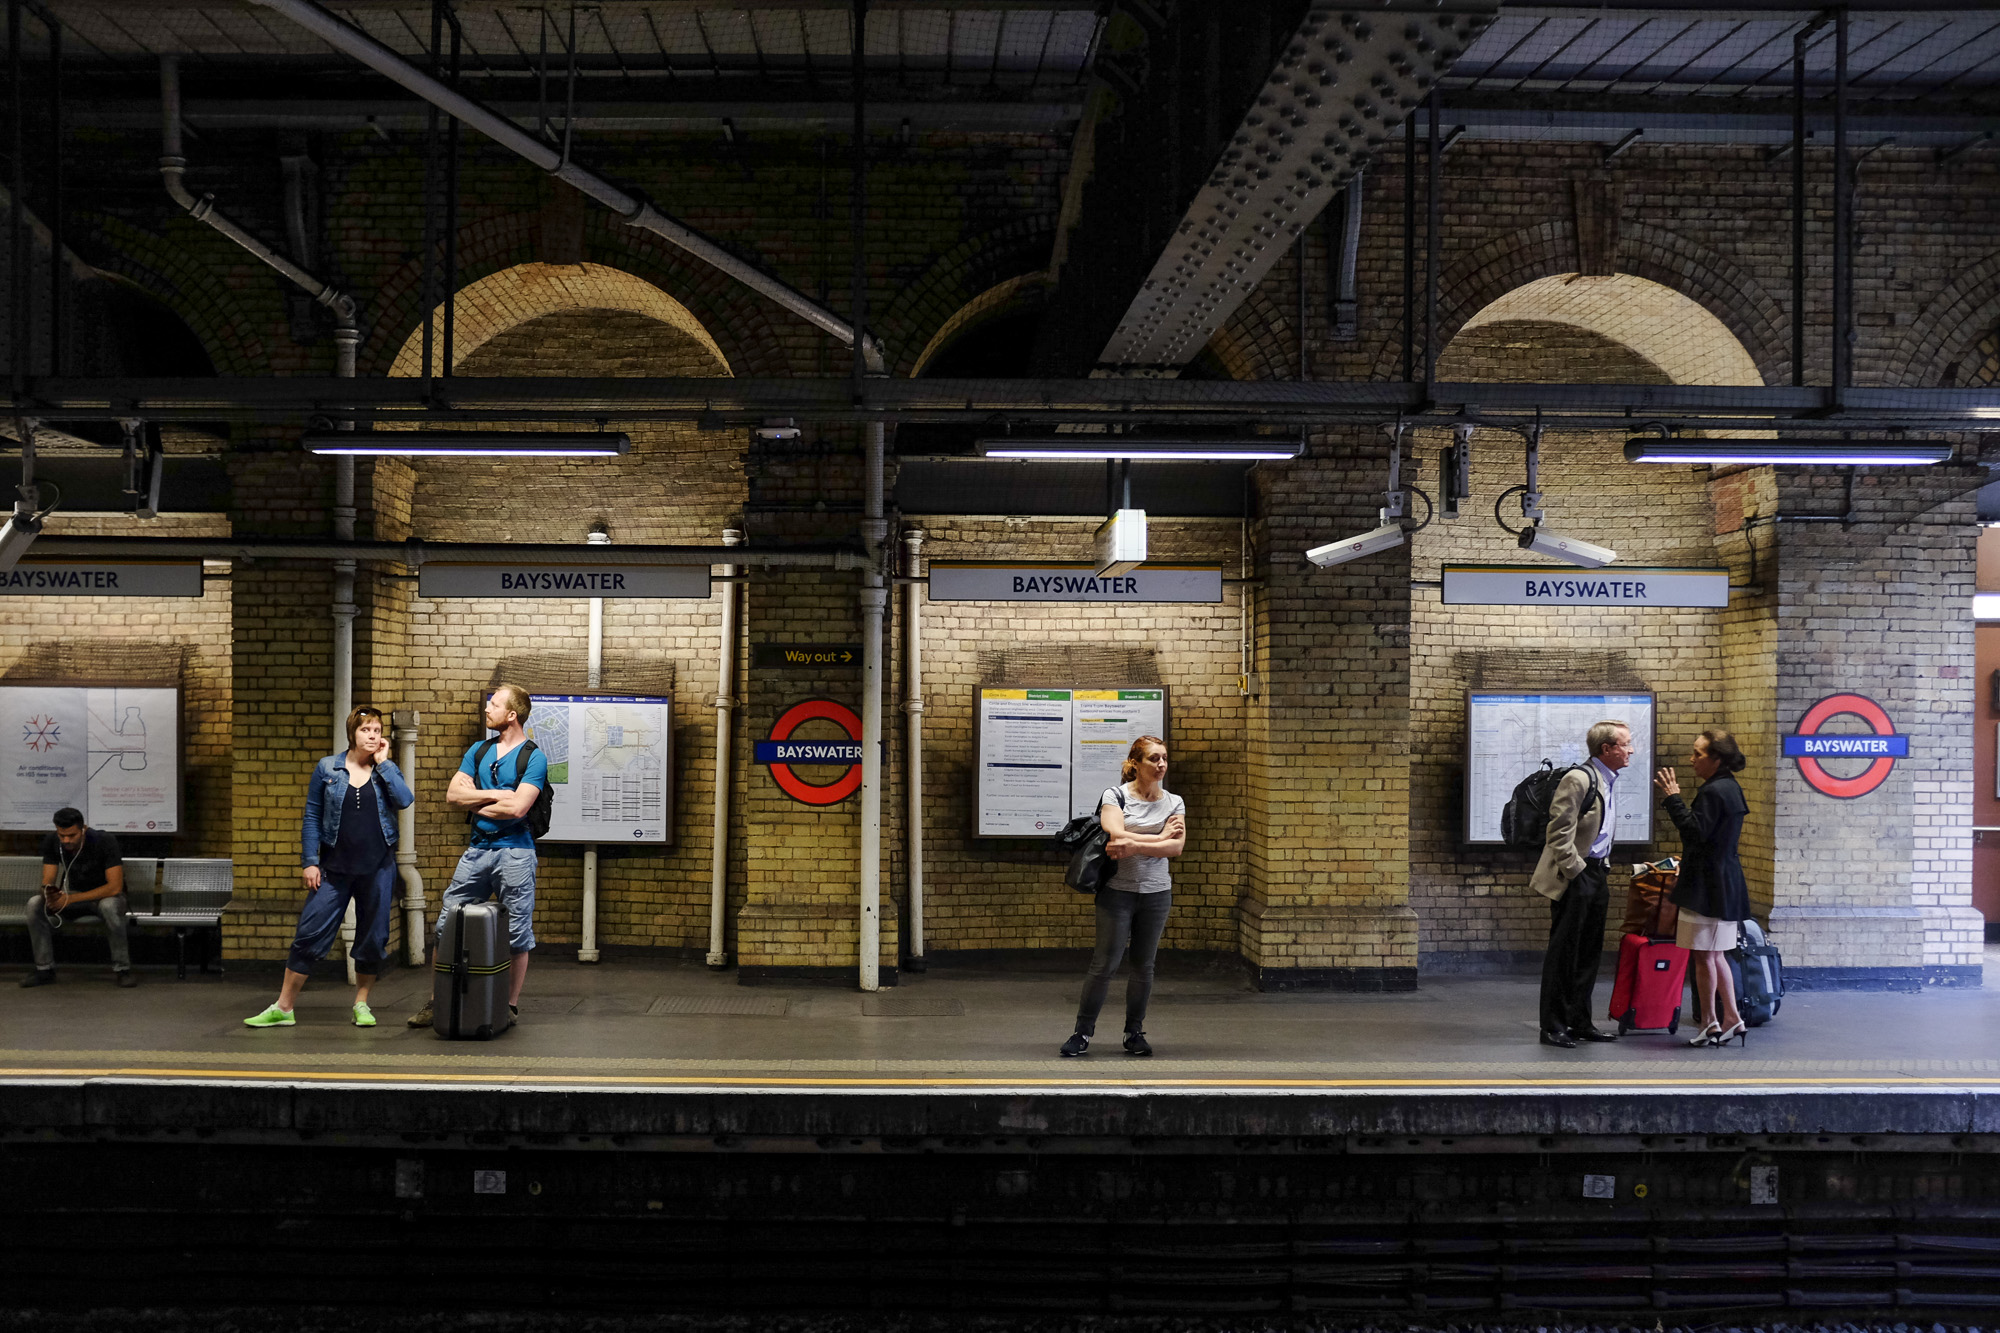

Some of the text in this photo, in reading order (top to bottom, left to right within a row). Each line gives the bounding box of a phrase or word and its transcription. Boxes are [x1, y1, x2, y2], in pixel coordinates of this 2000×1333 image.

[0, 570, 119, 588] BAYSWATER
[501, 573, 626, 590] BAYSWATER
[1012, 576, 1139, 594] BAYSWATER
[1525, 580, 1648, 598] BAYSWATER
[785, 651, 837, 664] Way out
[776, 746, 863, 758] BAYSWATER
[1804, 740, 1889, 752] BAYSWATER
